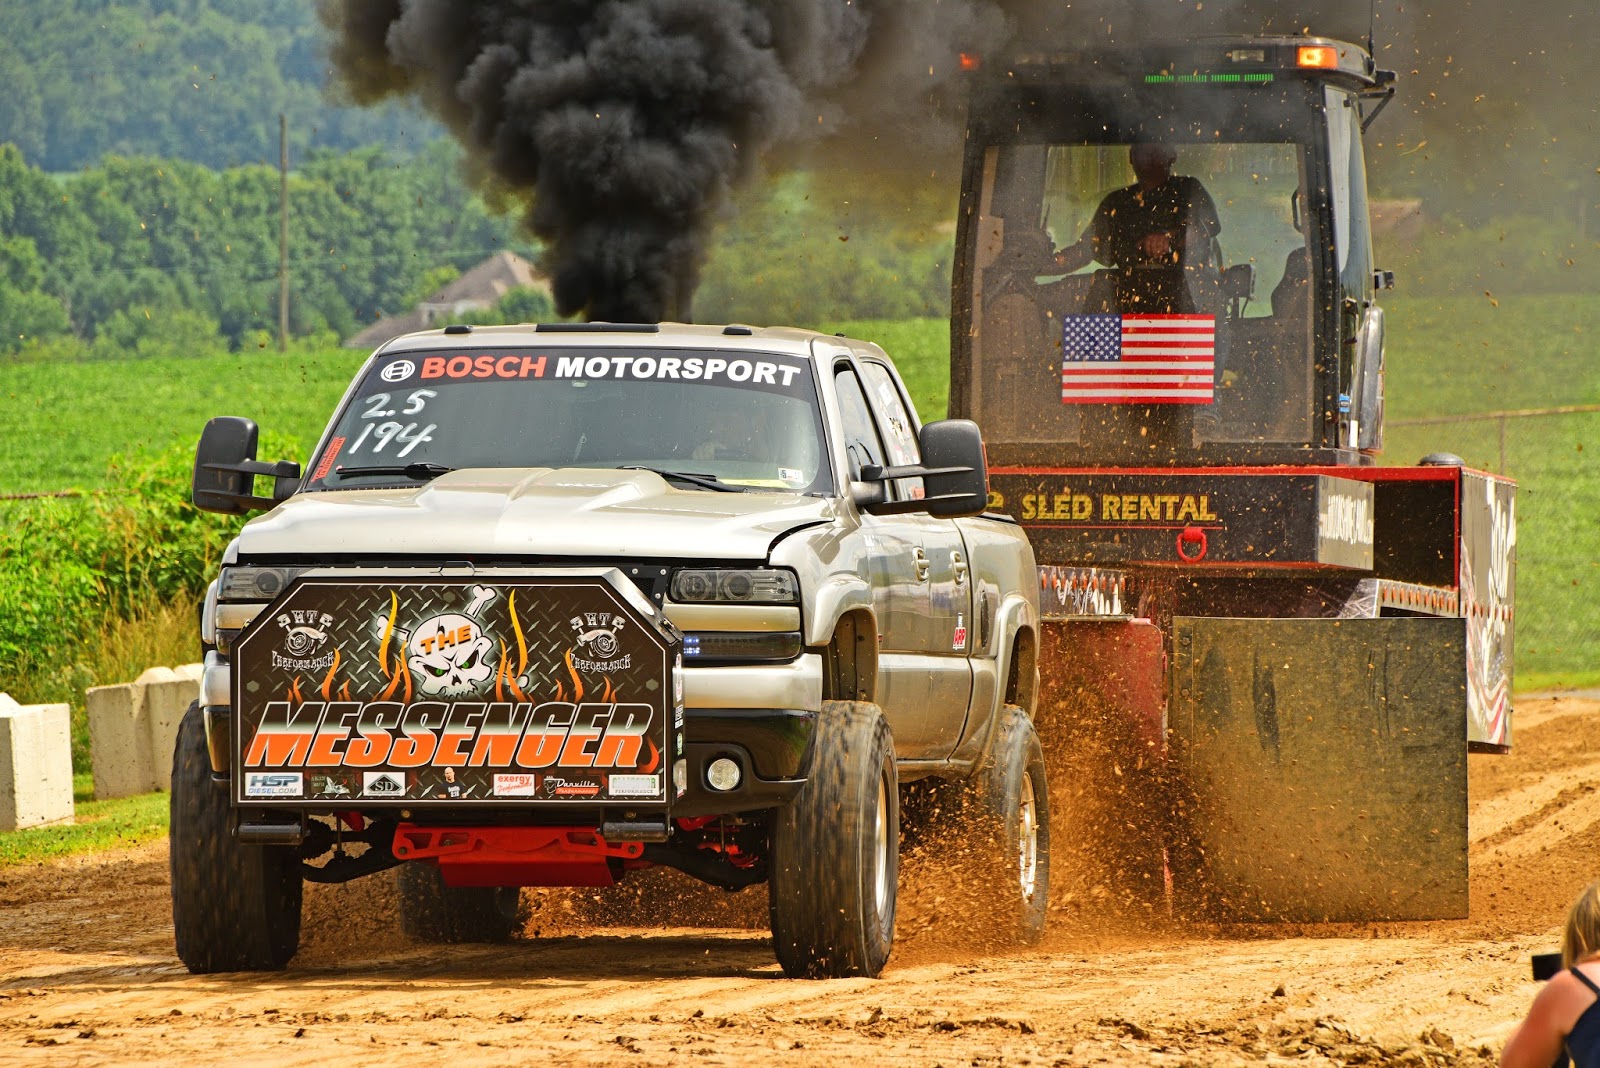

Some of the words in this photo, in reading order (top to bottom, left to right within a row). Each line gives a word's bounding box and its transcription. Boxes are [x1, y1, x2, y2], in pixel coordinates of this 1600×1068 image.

[420, 356, 547, 379] BOSCH
[555, 356, 801, 386] MOTORSPORT
[361, 389, 438, 419] 2.5
[348, 421, 438, 457] 194
[1021, 493, 1093, 520] SLED
[1102, 494, 1217, 521] RENTAL
[420, 624, 471, 655] THE
[244, 701, 654, 768] MESSENGER
[250, 775, 300, 787] HSP
[374, 781, 395, 791] SD
[498, 775, 531, 786] exergy
[556, 778, 599, 788] Danville
